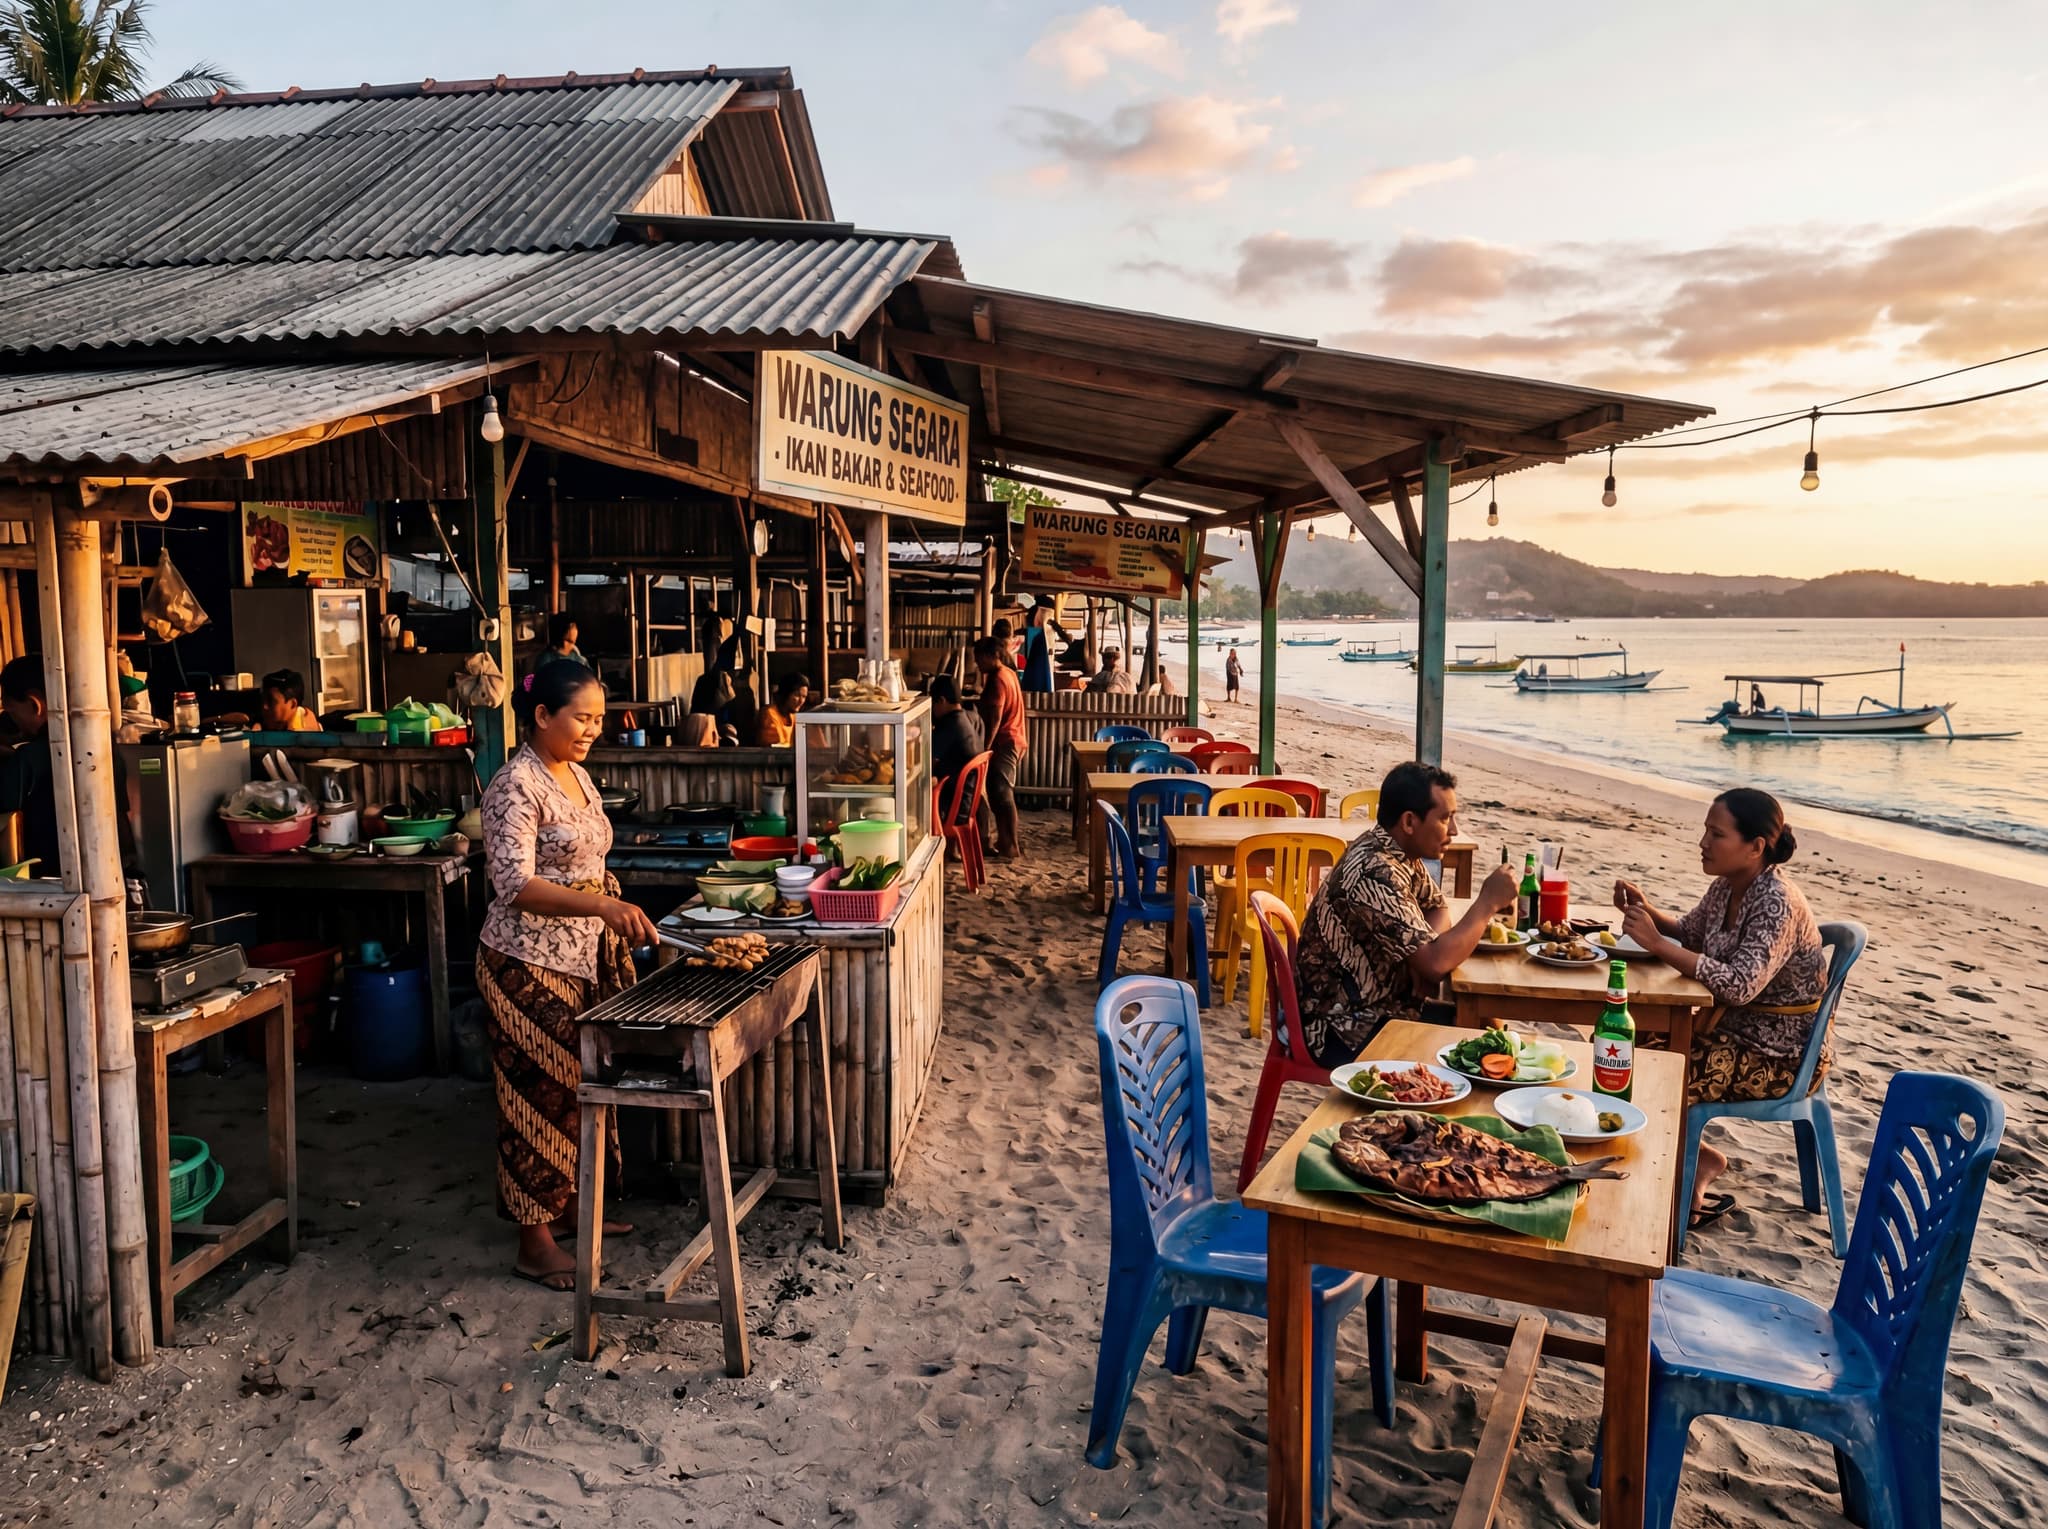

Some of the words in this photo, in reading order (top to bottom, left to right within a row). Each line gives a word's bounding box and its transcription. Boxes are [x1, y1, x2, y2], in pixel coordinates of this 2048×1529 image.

[776, 356, 882, 446] WARUNG
[889, 398, 961, 468] SEGARA
[786, 435, 827, 478] IKAN
[832, 447, 882, 489] BAKAR
[885, 461, 895, 491] &
[899, 464, 955, 503] SEAFOOD
[1033, 511, 1108, 536] WARUNG
[1113, 520, 1182, 544] SEGARA
